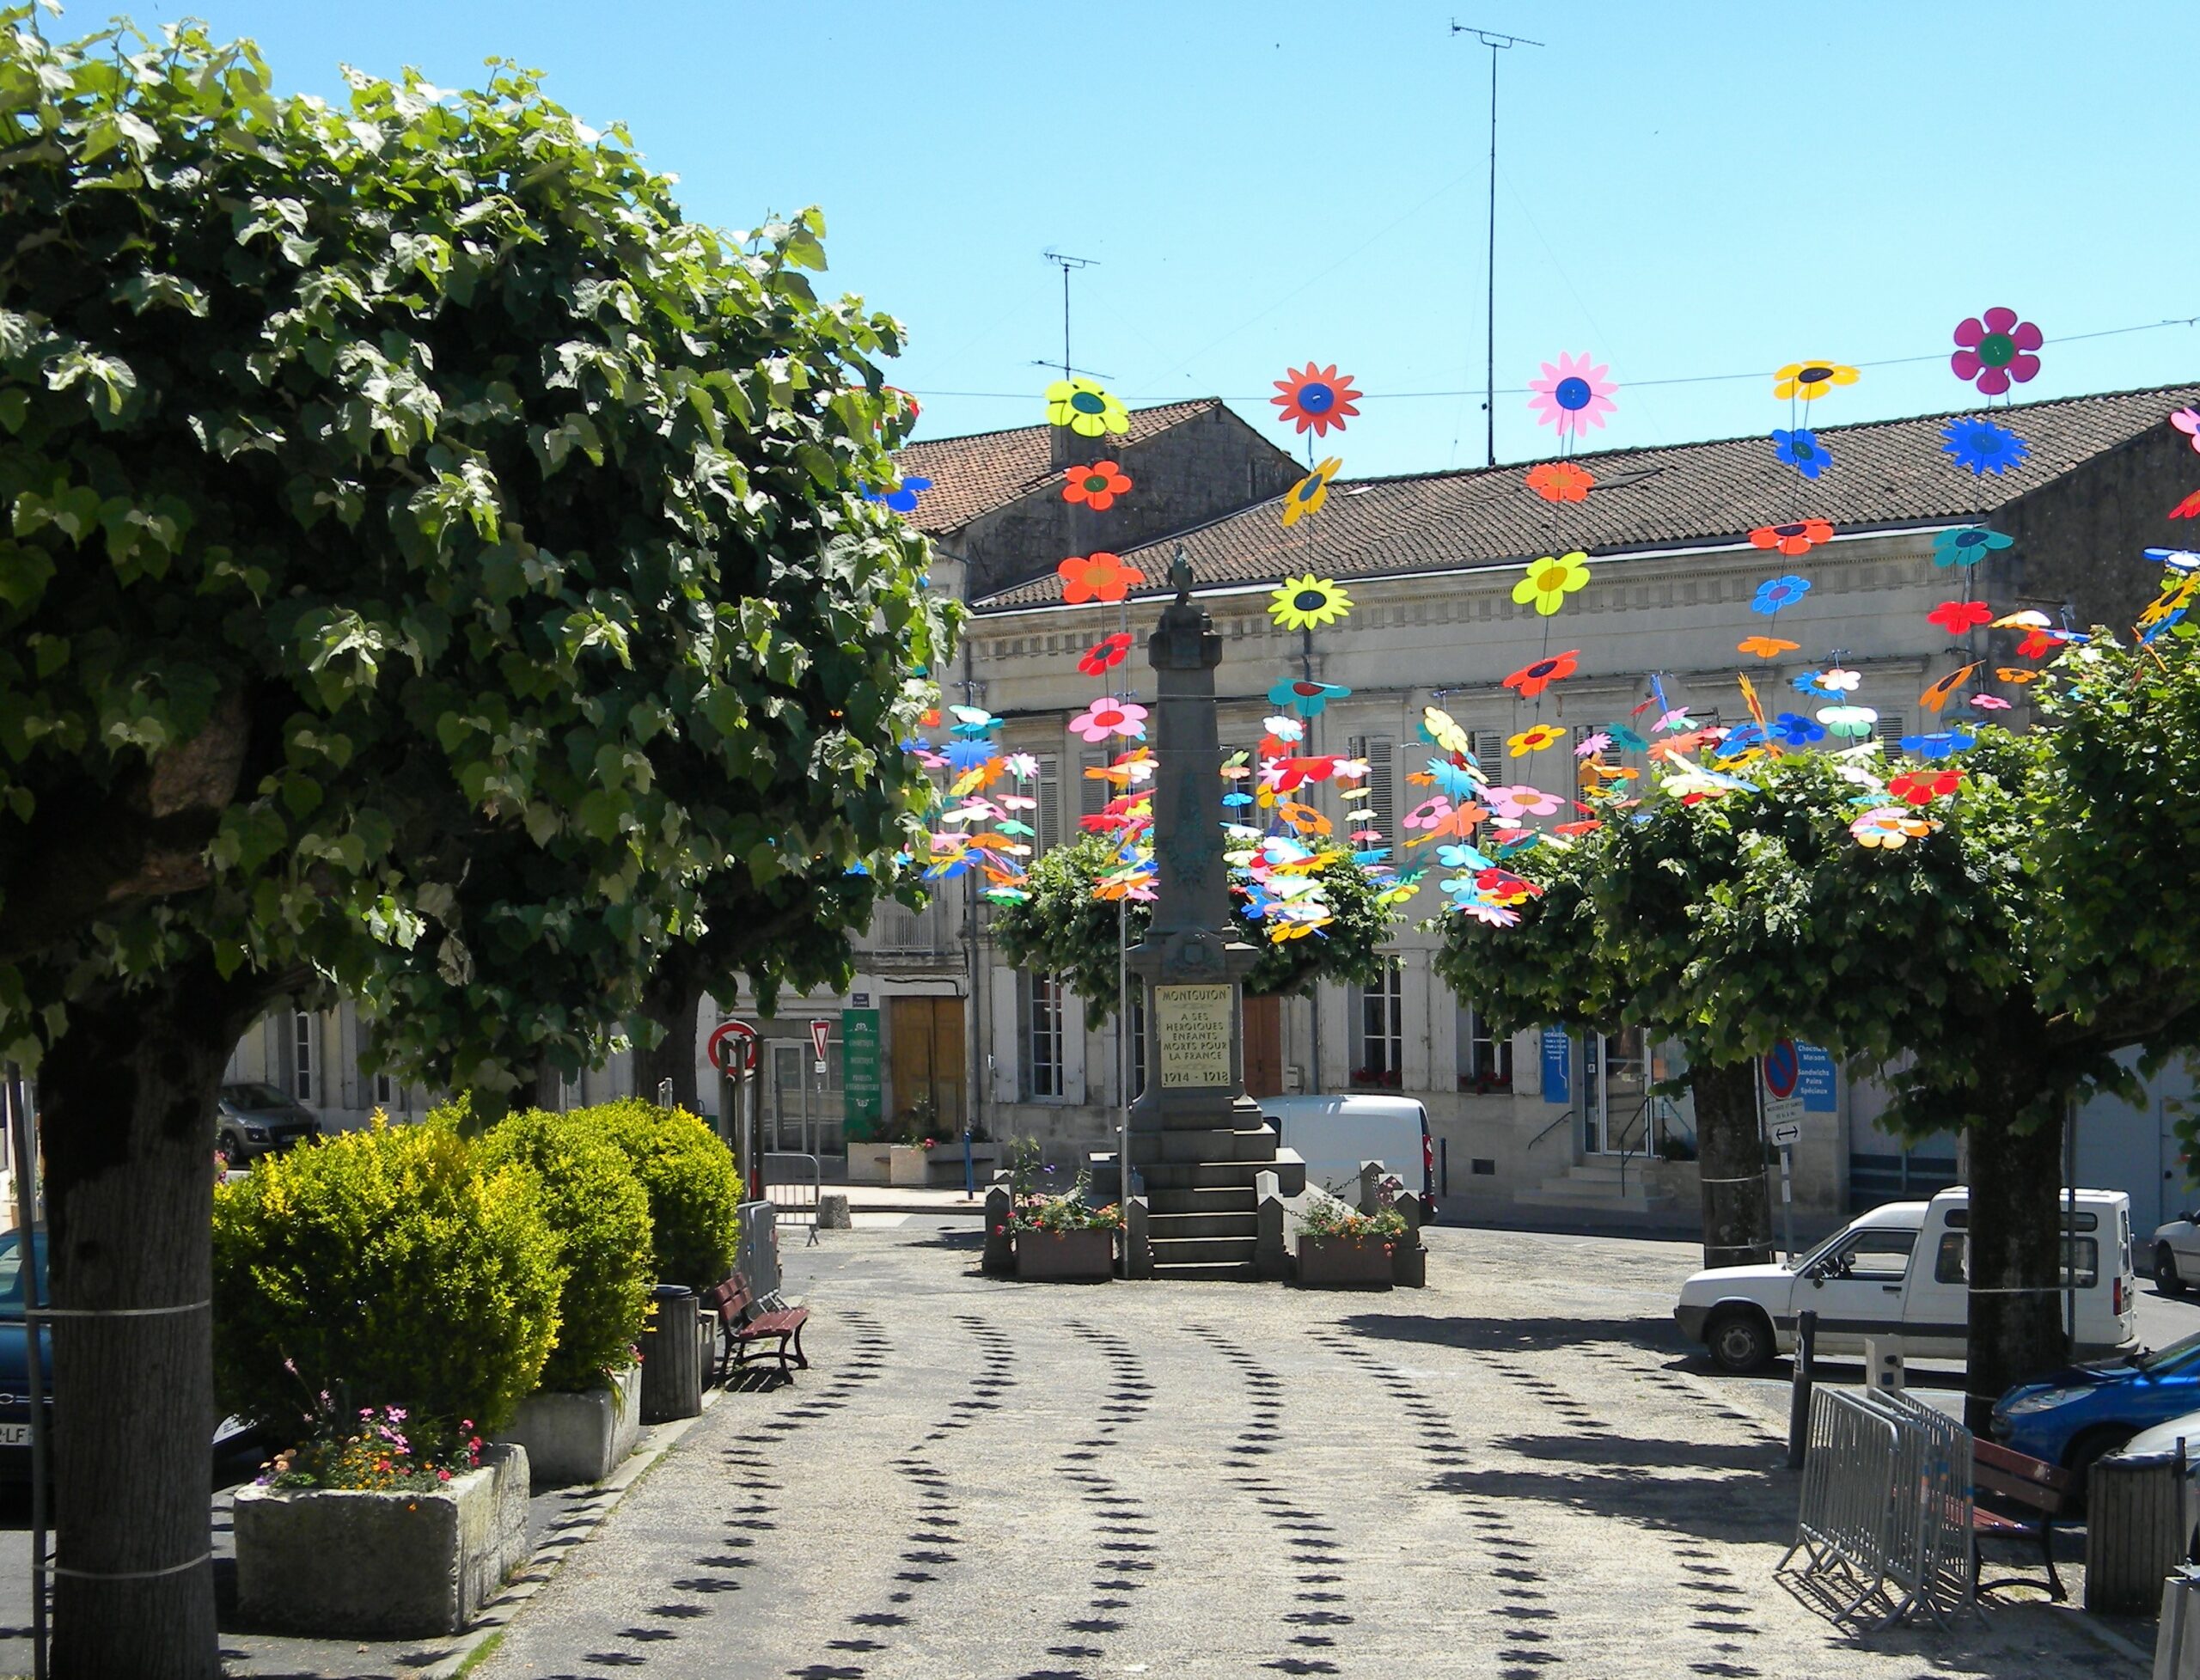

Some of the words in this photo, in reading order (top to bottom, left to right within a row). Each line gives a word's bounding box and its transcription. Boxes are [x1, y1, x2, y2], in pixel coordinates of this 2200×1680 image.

[1163, 990, 1226, 1001] MONTGUYON
[1193, 1012, 1209, 1021] SES
[1173, 1032, 1218, 1041] ENFANTS
[1164, 1042, 1197, 1050] MORTS
[1201, 1042, 1227, 1050] POUR
[1169, 1052, 1181, 1060] LA
[1184, 1051, 1222, 1060] FRANCE
[1164, 1072, 1189, 1083] 1914
[1203, 1071, 1229, 1082] 1918
